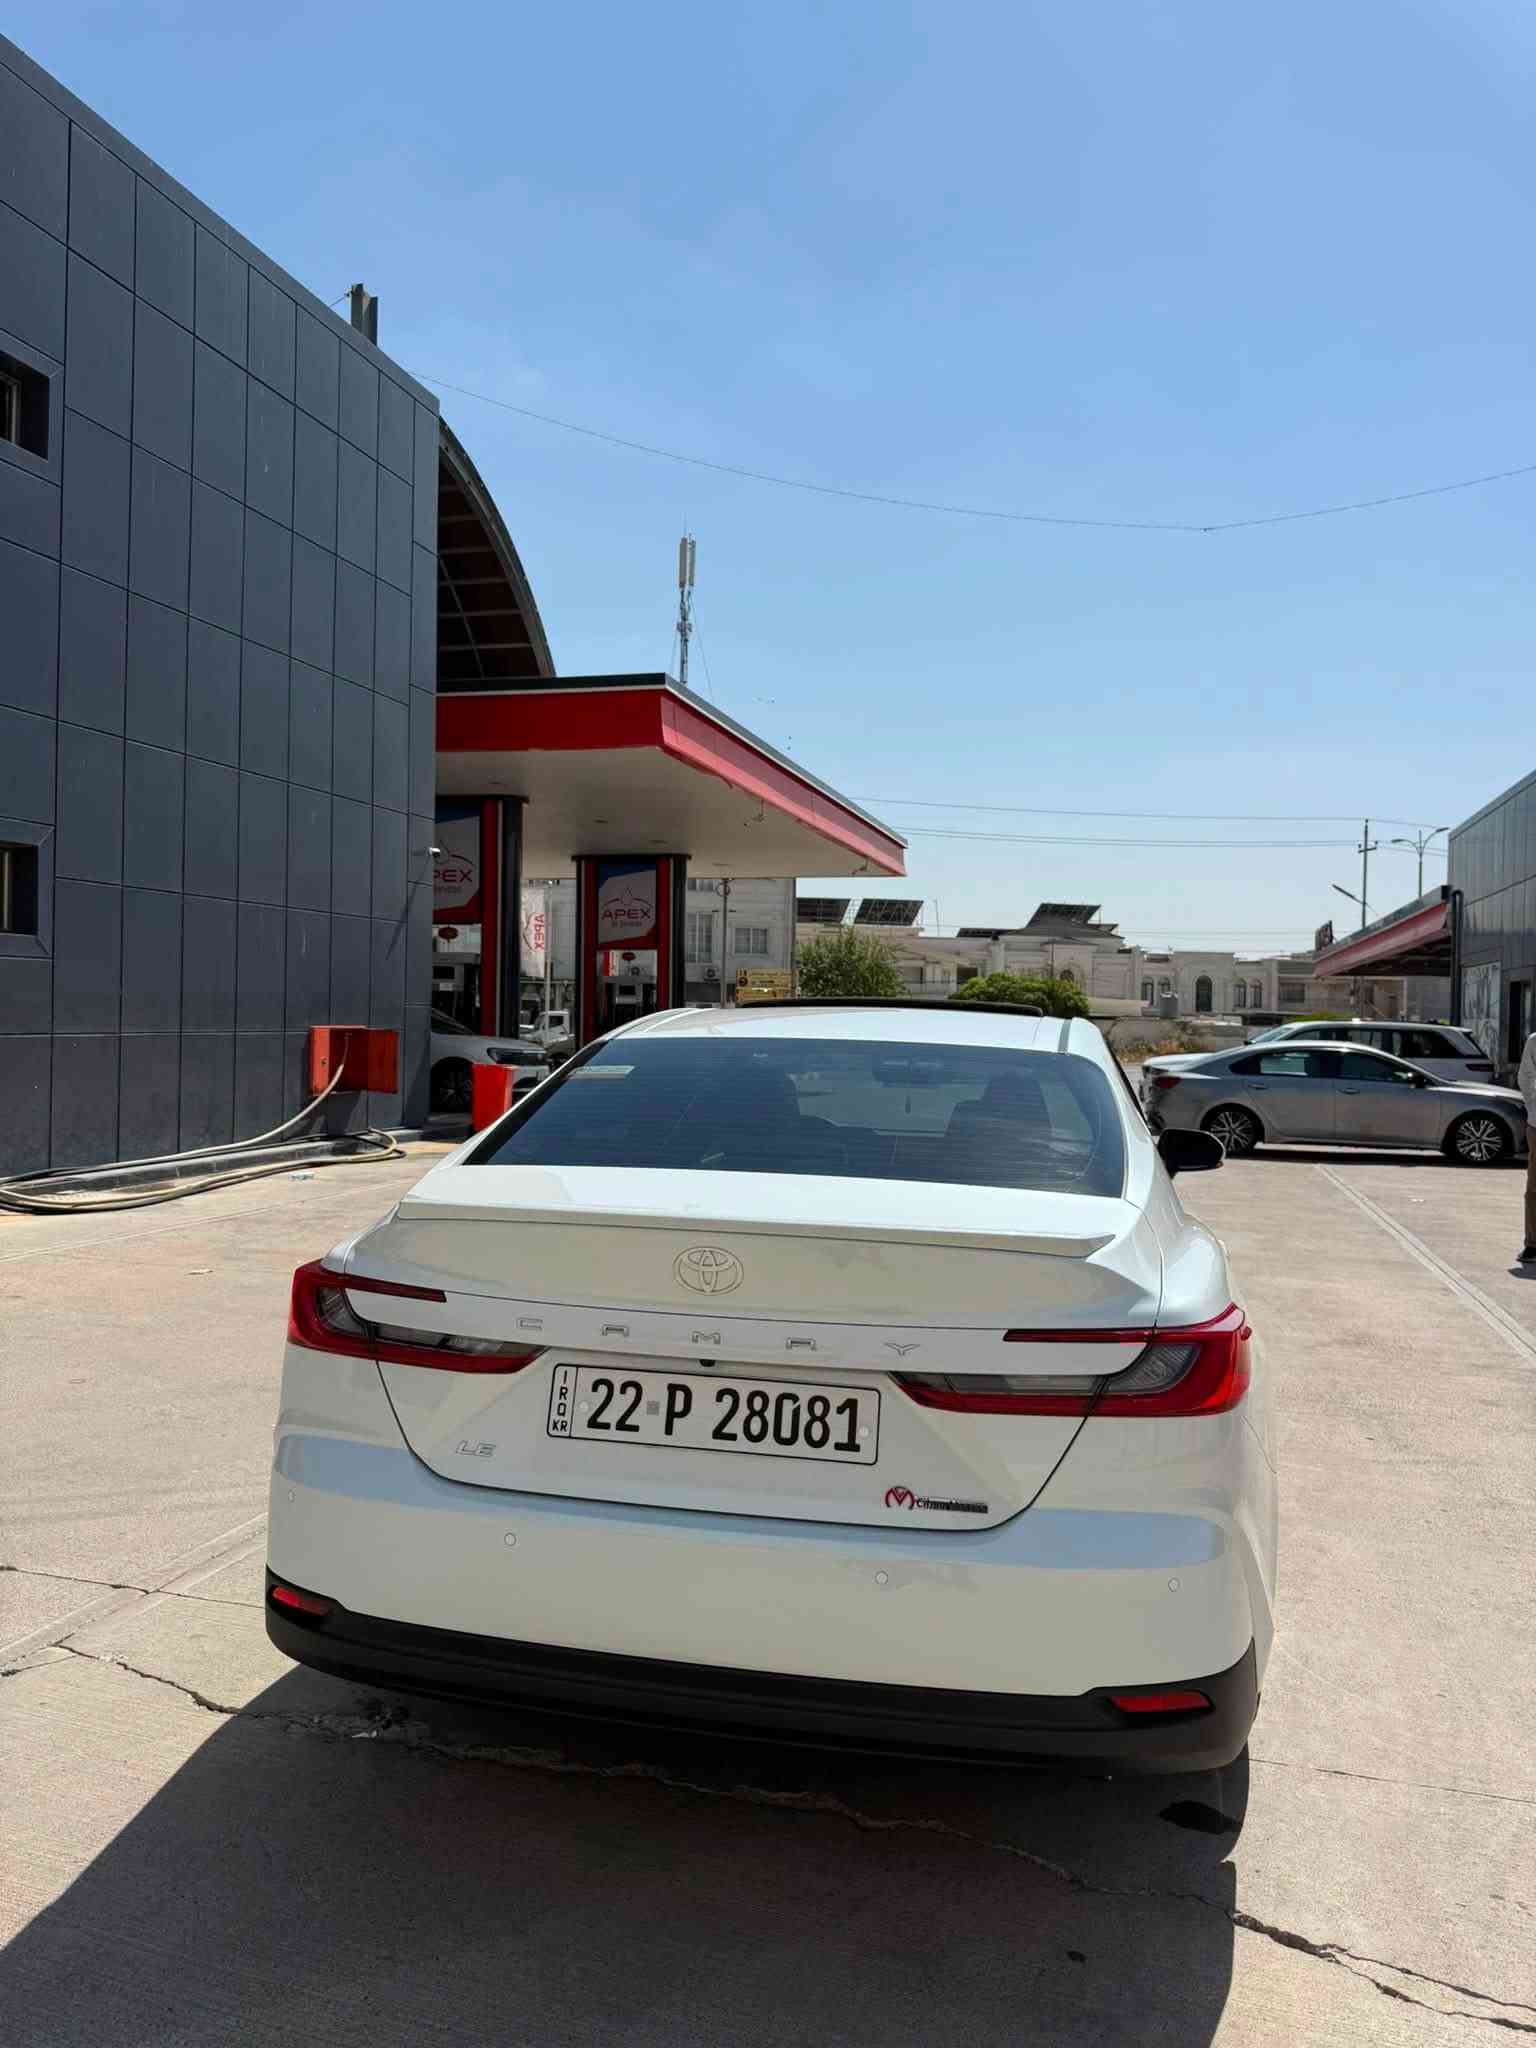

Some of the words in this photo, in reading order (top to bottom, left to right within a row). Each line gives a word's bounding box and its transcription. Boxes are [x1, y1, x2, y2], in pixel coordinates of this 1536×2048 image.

[433, 869, 473, 882] PEX
[601, 908, 651, 920] APEX
[516, 1317, 921, 1357] CAMRY
[587, 1378, 643, 1432] 22
[664, 1383, 693, 1436] P
[711, 1387, 861, 1453] 28081
[552, 1419, 568, 1432] KR
[456, 1440, 497, 1457] LE
